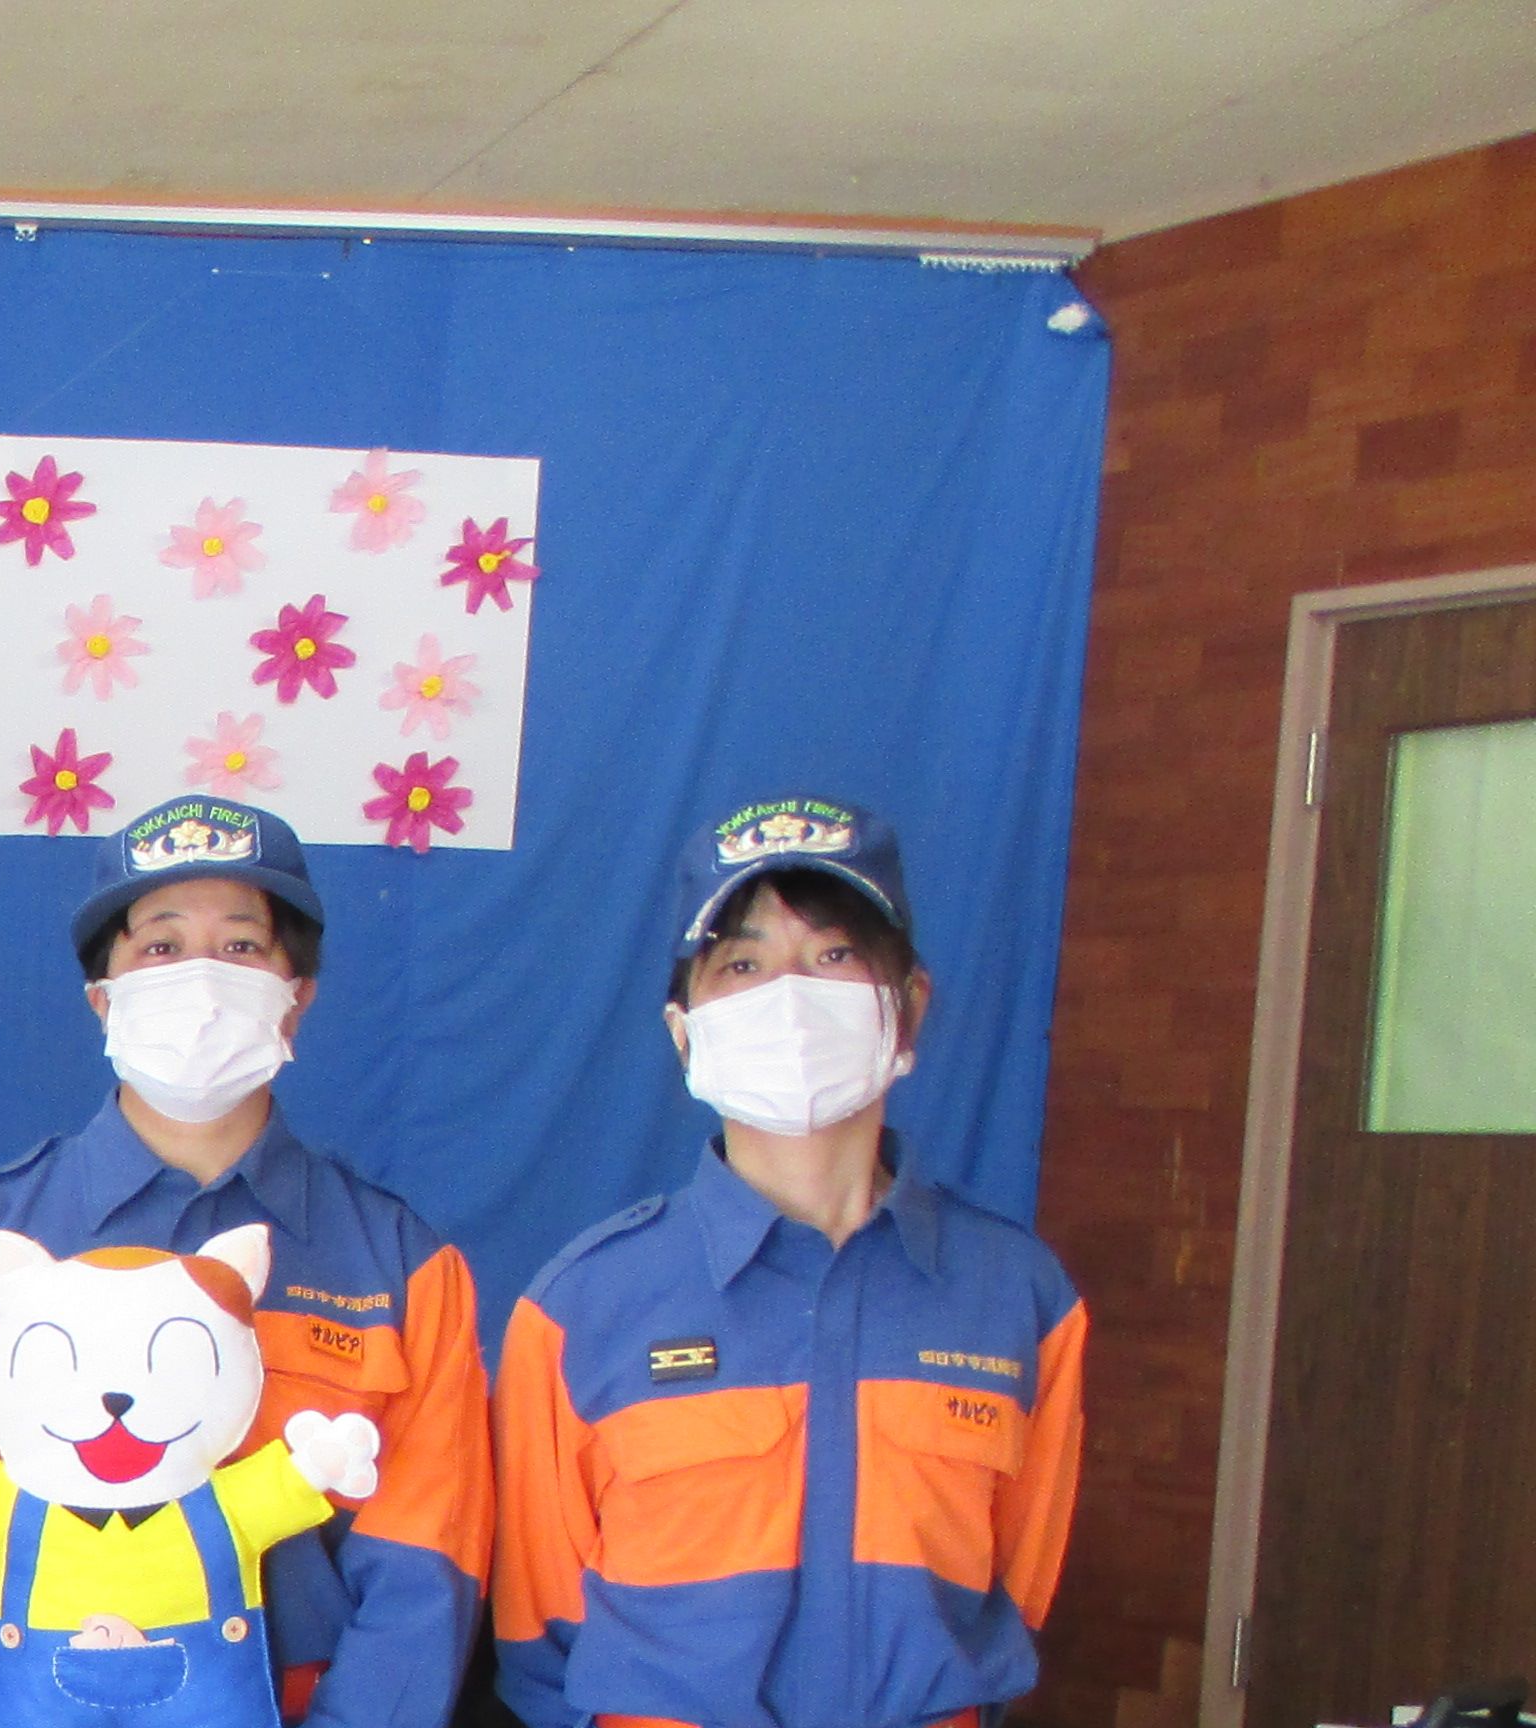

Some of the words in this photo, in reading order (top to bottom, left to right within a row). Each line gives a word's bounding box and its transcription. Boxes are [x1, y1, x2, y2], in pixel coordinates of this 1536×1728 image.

[129, 803, 203, 841] YOKKAICHI
[311, 1322, 361, 1354] サルビア
